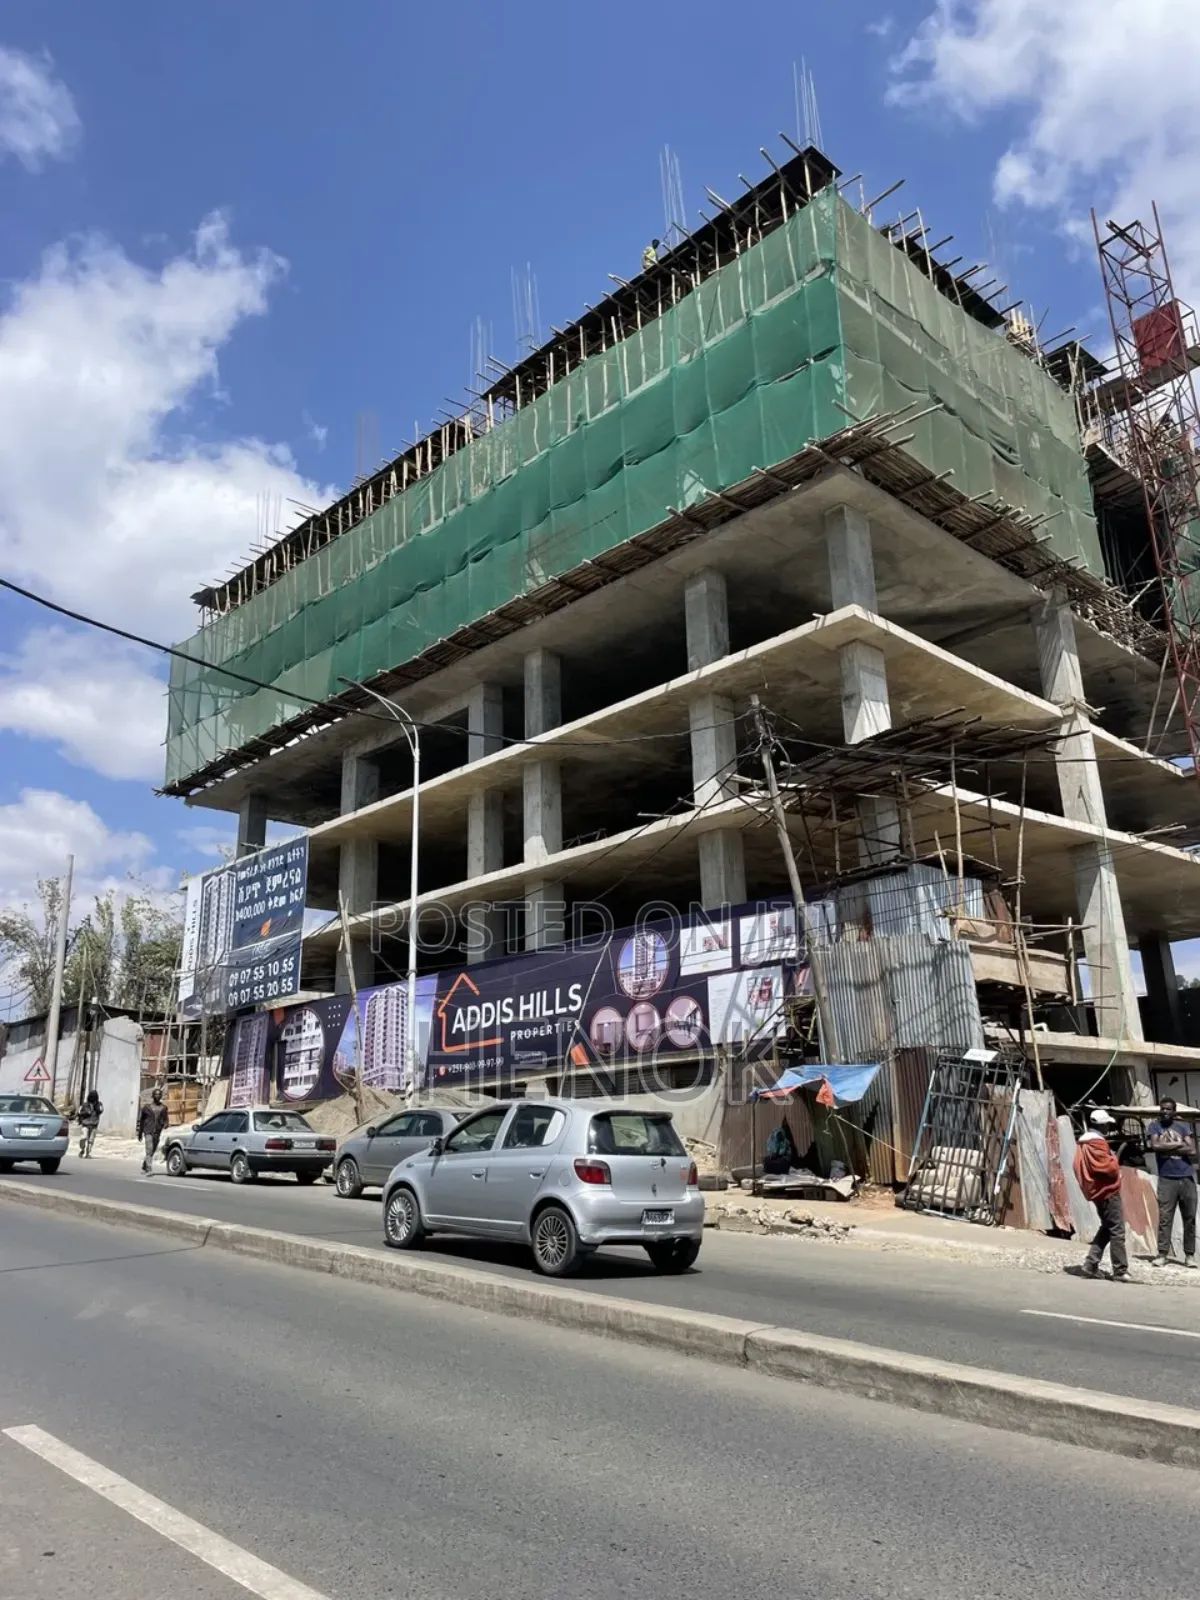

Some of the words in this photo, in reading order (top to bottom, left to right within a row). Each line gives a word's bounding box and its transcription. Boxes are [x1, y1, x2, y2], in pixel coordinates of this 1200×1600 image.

[228, 972, 239, 987] 09
[240, 968, 251, 984] 07
[253, 966, 265, 981] 55
[268, 961, 279, 976] 10
[282, 957, 295, 973] 55
[228, 991, 239, 1006] 09
[240, 988, 251, 1003] 07
[253, 985, 265, 1000] 55
[267, 981, 279, 997] 20
[281, 977, 294, 993] 55
[451, 997, 514, 1034] ADDIS
[519, 983, 582, 1021] HILLS
[510, 1019, 581, 1041] PROPERTIES
